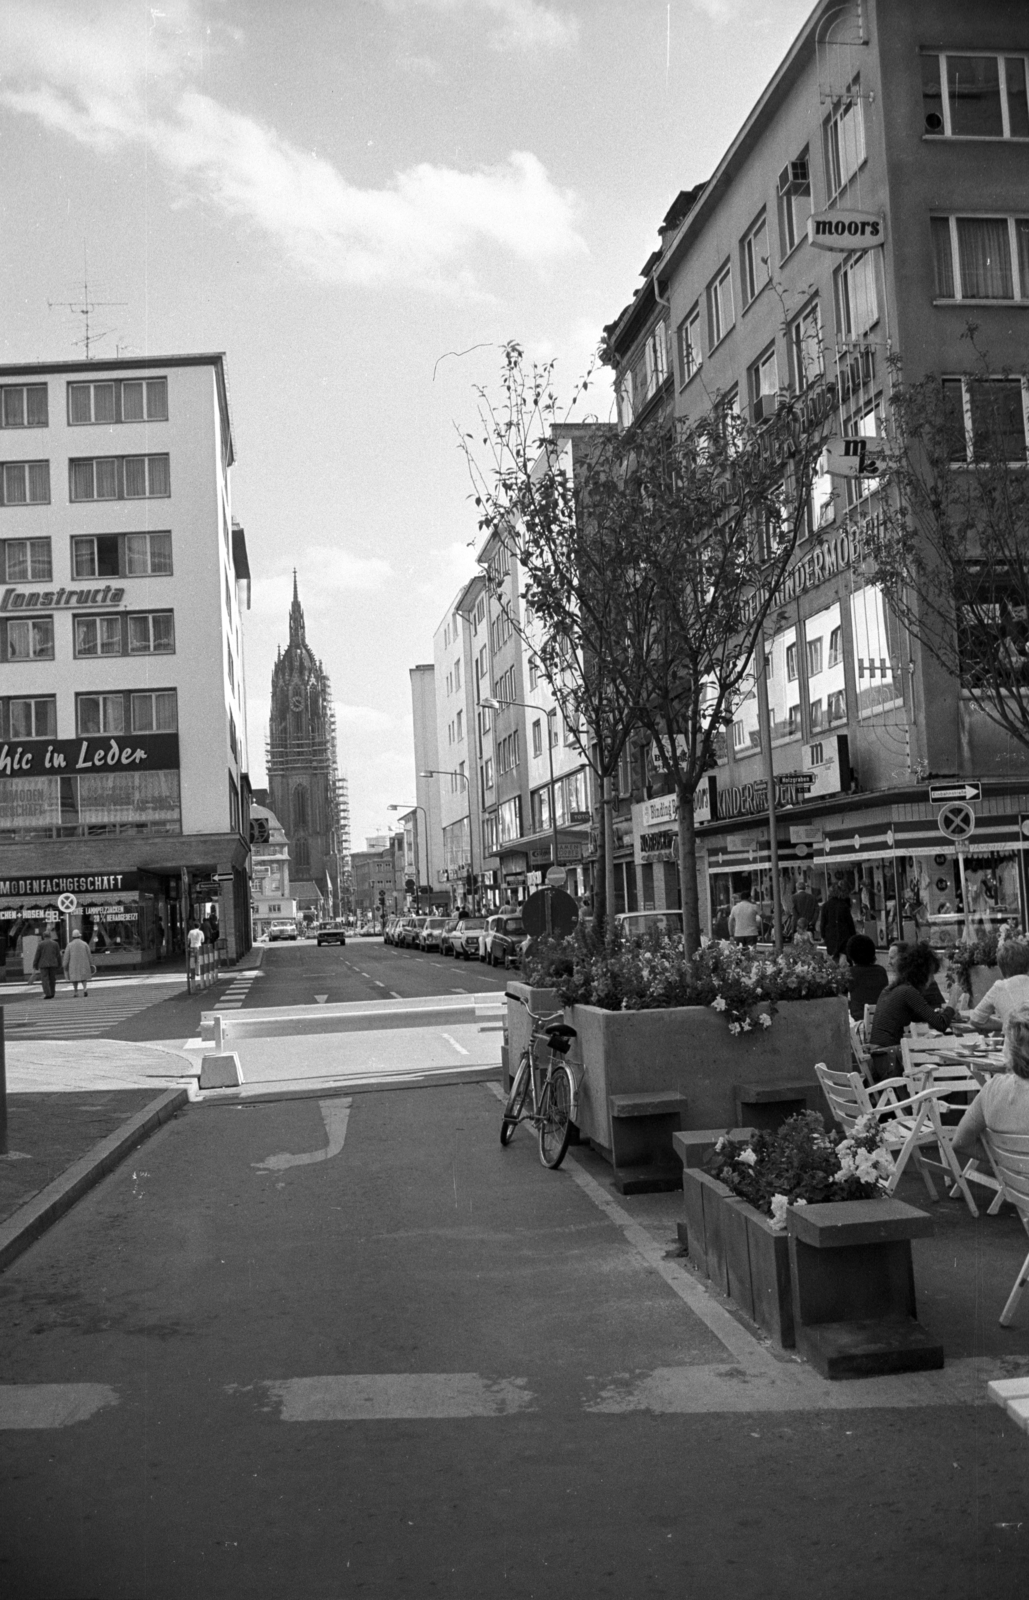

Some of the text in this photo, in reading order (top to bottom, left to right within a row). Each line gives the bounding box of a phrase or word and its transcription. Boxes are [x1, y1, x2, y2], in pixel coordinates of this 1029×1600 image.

[815, 217, 880, 236] moors
[0, 585, 125, 612] Constructa
[44, 745, 67, 769] in
[75, 738, 147, 769] Leder
[782, 776, 810, 784] Holzgraben
[651, 801, 672, 821] Binding
[0, 876, 123, 893] MODENFACHGESCHÄFT
